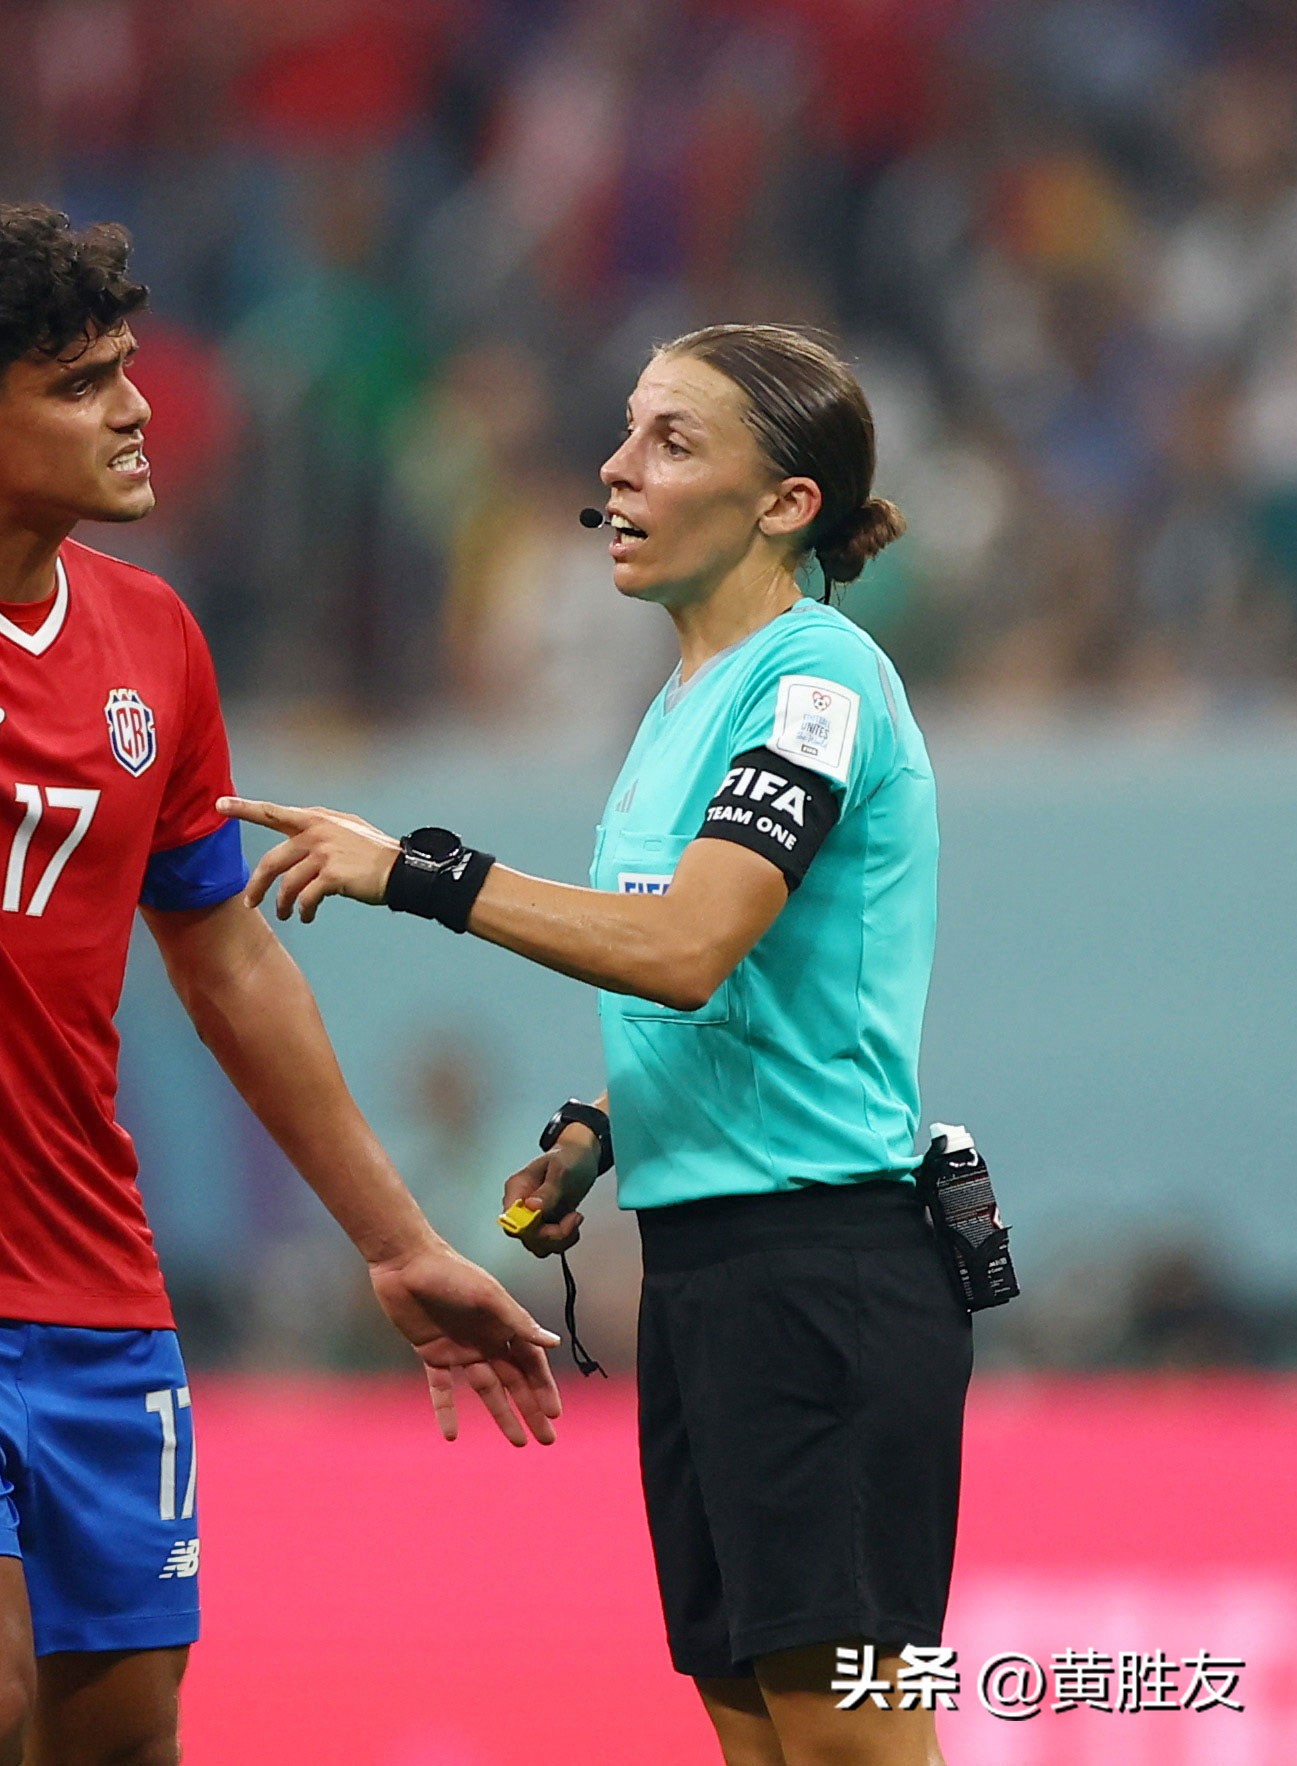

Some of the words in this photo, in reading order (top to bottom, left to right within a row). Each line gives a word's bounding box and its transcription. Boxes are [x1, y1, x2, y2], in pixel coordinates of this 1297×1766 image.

[714, 767, 806, 827] FIFA
[2, 782, 102, 917] 17
[707, 806, 753, 825] TEAM
[756, 816, 798, 851] ONE
